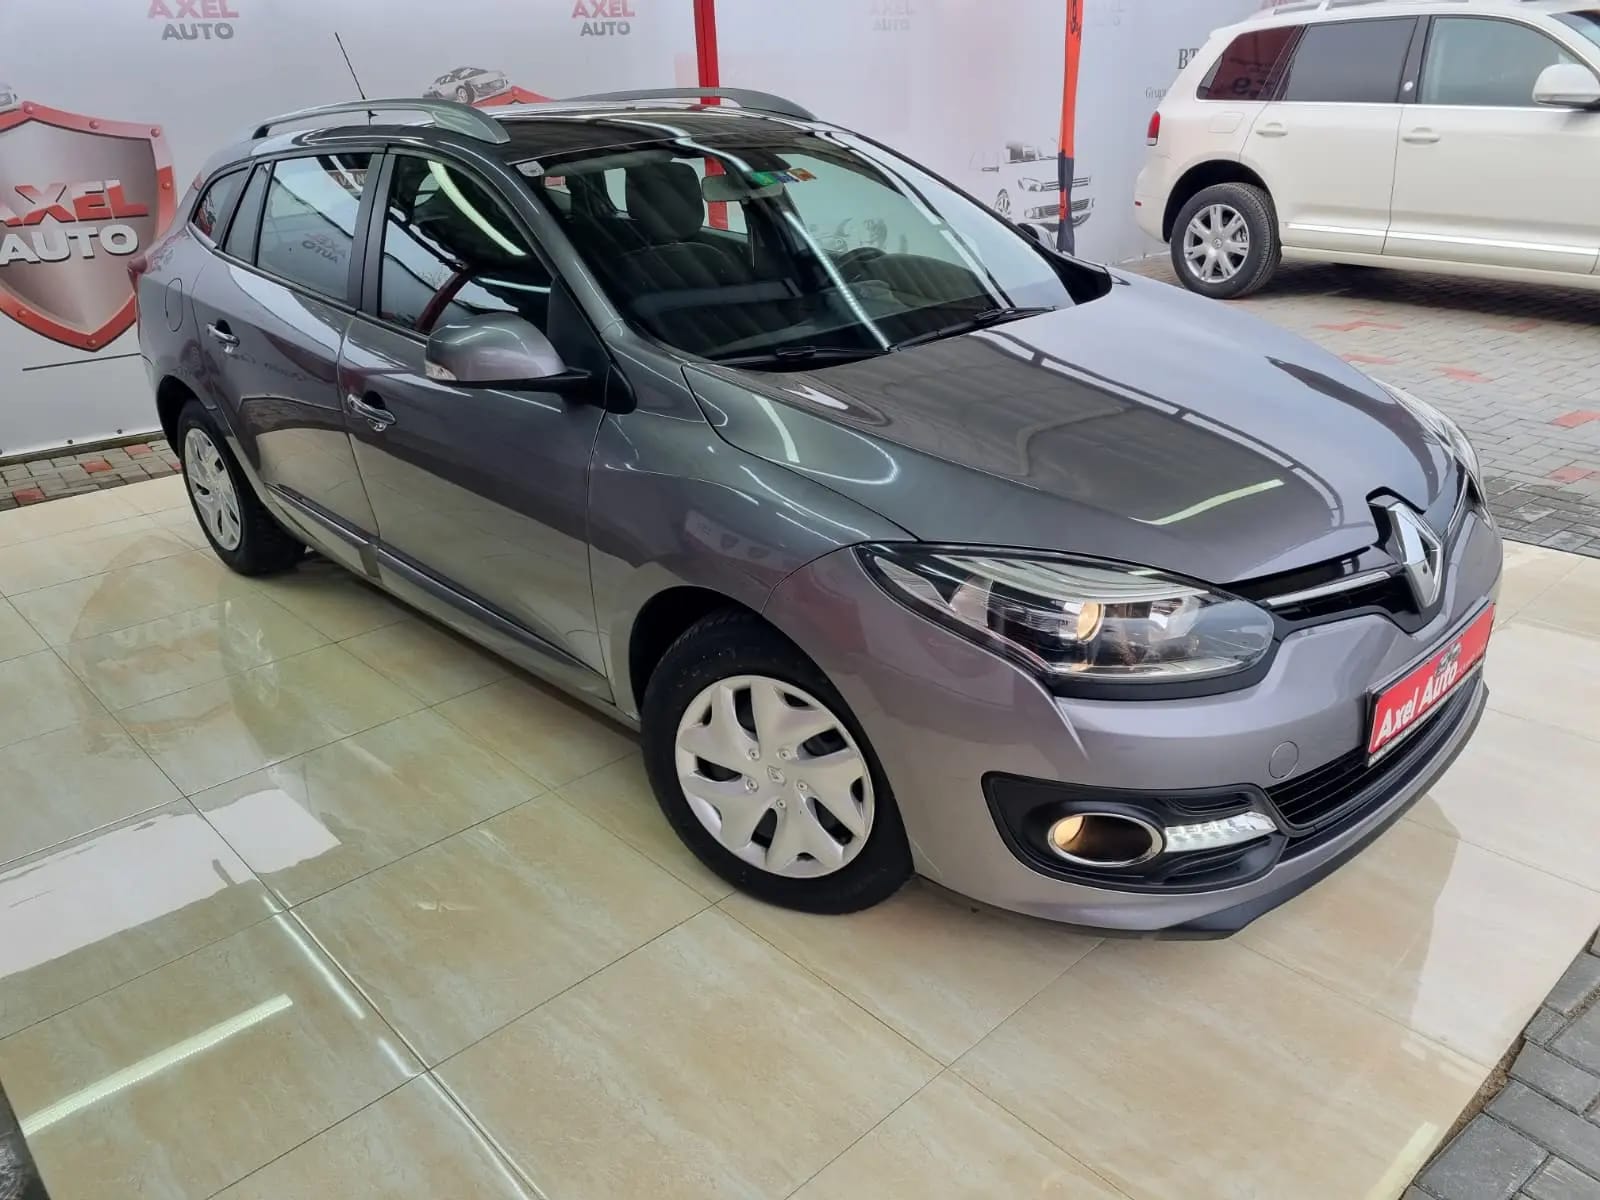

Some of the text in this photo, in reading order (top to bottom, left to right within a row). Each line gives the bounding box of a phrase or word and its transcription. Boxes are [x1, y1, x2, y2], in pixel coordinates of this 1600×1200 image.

[147, 0, 240, 19] AXEL
[571, 0, 635, 18] AXEL
[161, 22, 234, 40] AUTO
[580, 21, 631, 37] AUTO
[0, 224, 139, 266] AUTO
[1373, 687, 1420, 748] Axel
[1418, 660, 1459, 713] Auto
